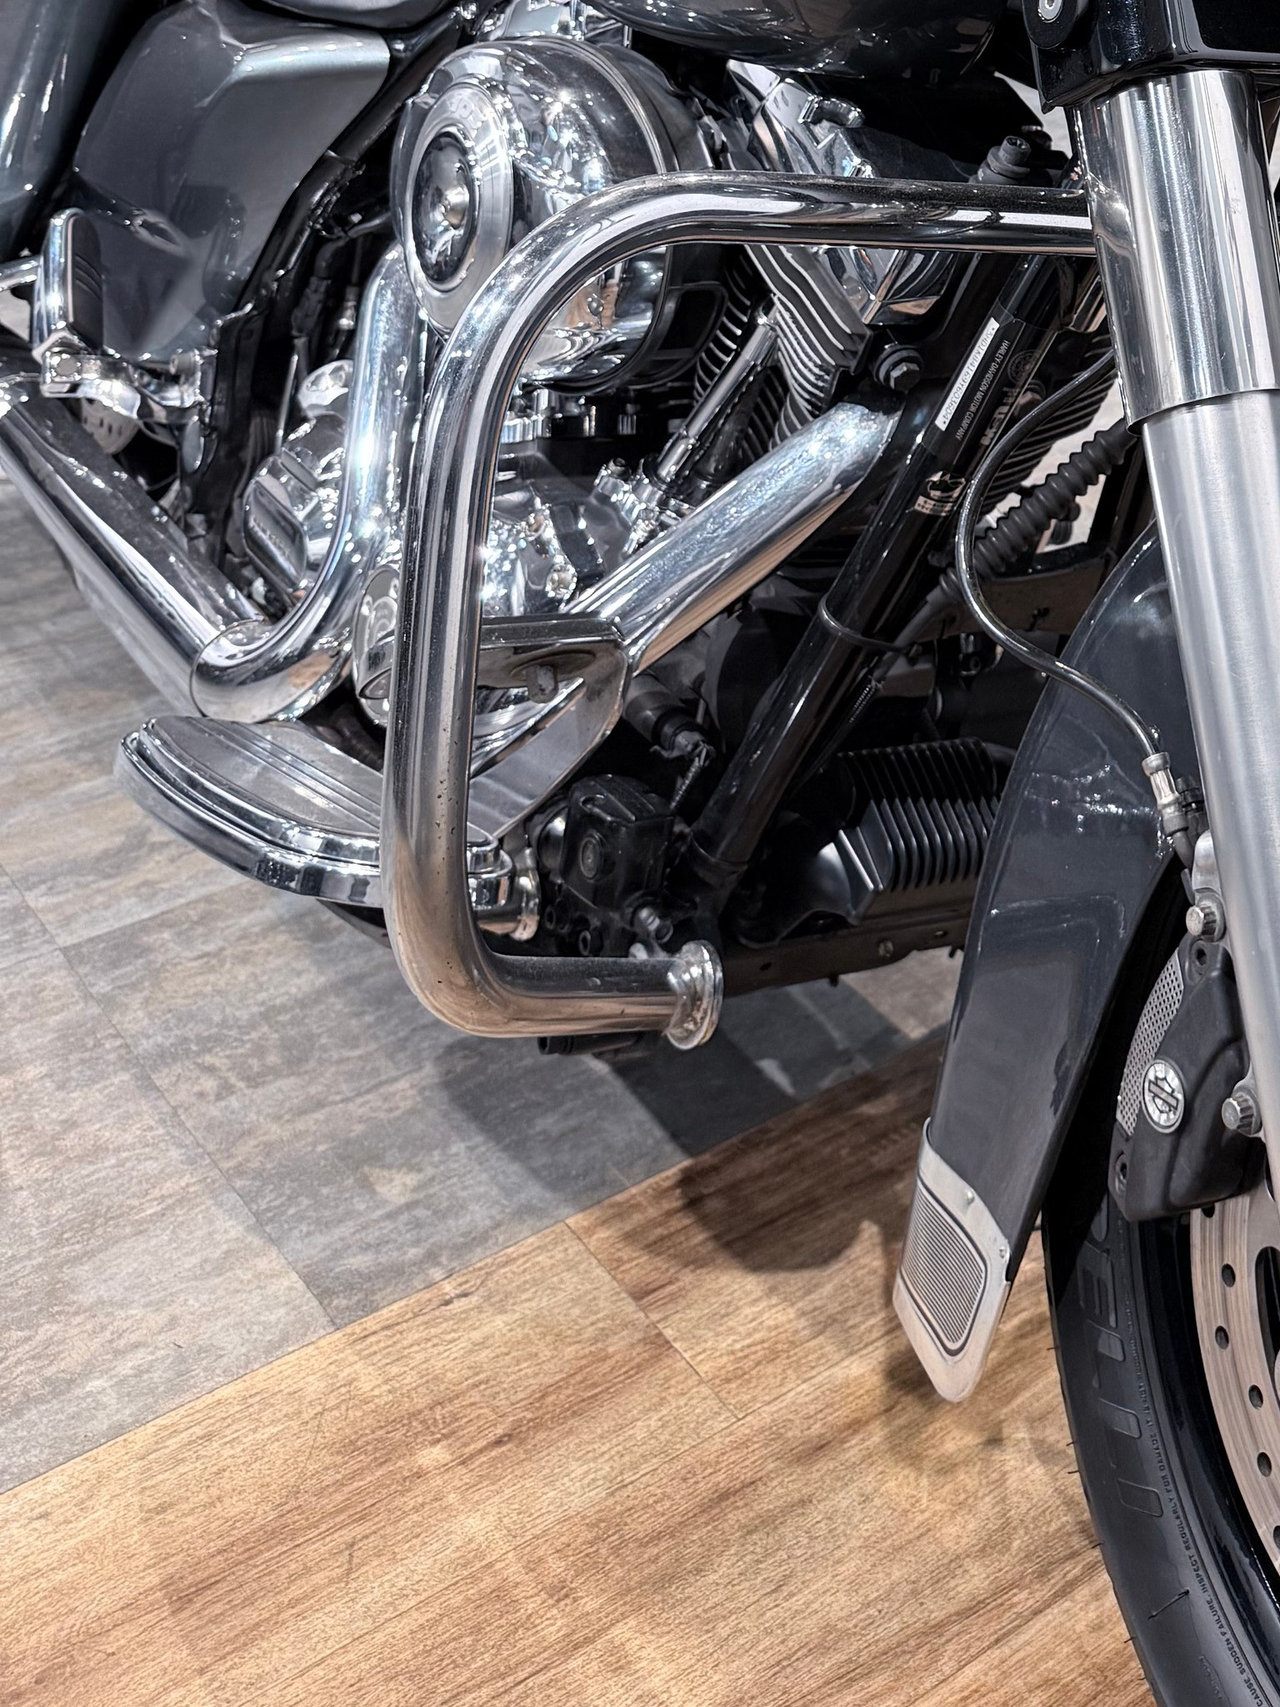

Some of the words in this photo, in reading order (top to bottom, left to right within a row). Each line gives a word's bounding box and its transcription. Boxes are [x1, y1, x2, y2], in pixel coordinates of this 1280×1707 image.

[967, 390, 984, 412] MOTOR
[954, 410, 974, 440] COMPANY
[1167, 1495, 1192, 1551] REGULARLY
[1187, 1553, 1209, 1594] INSPECT
[1222, 1637, 1247, 1676] SUDDEN
